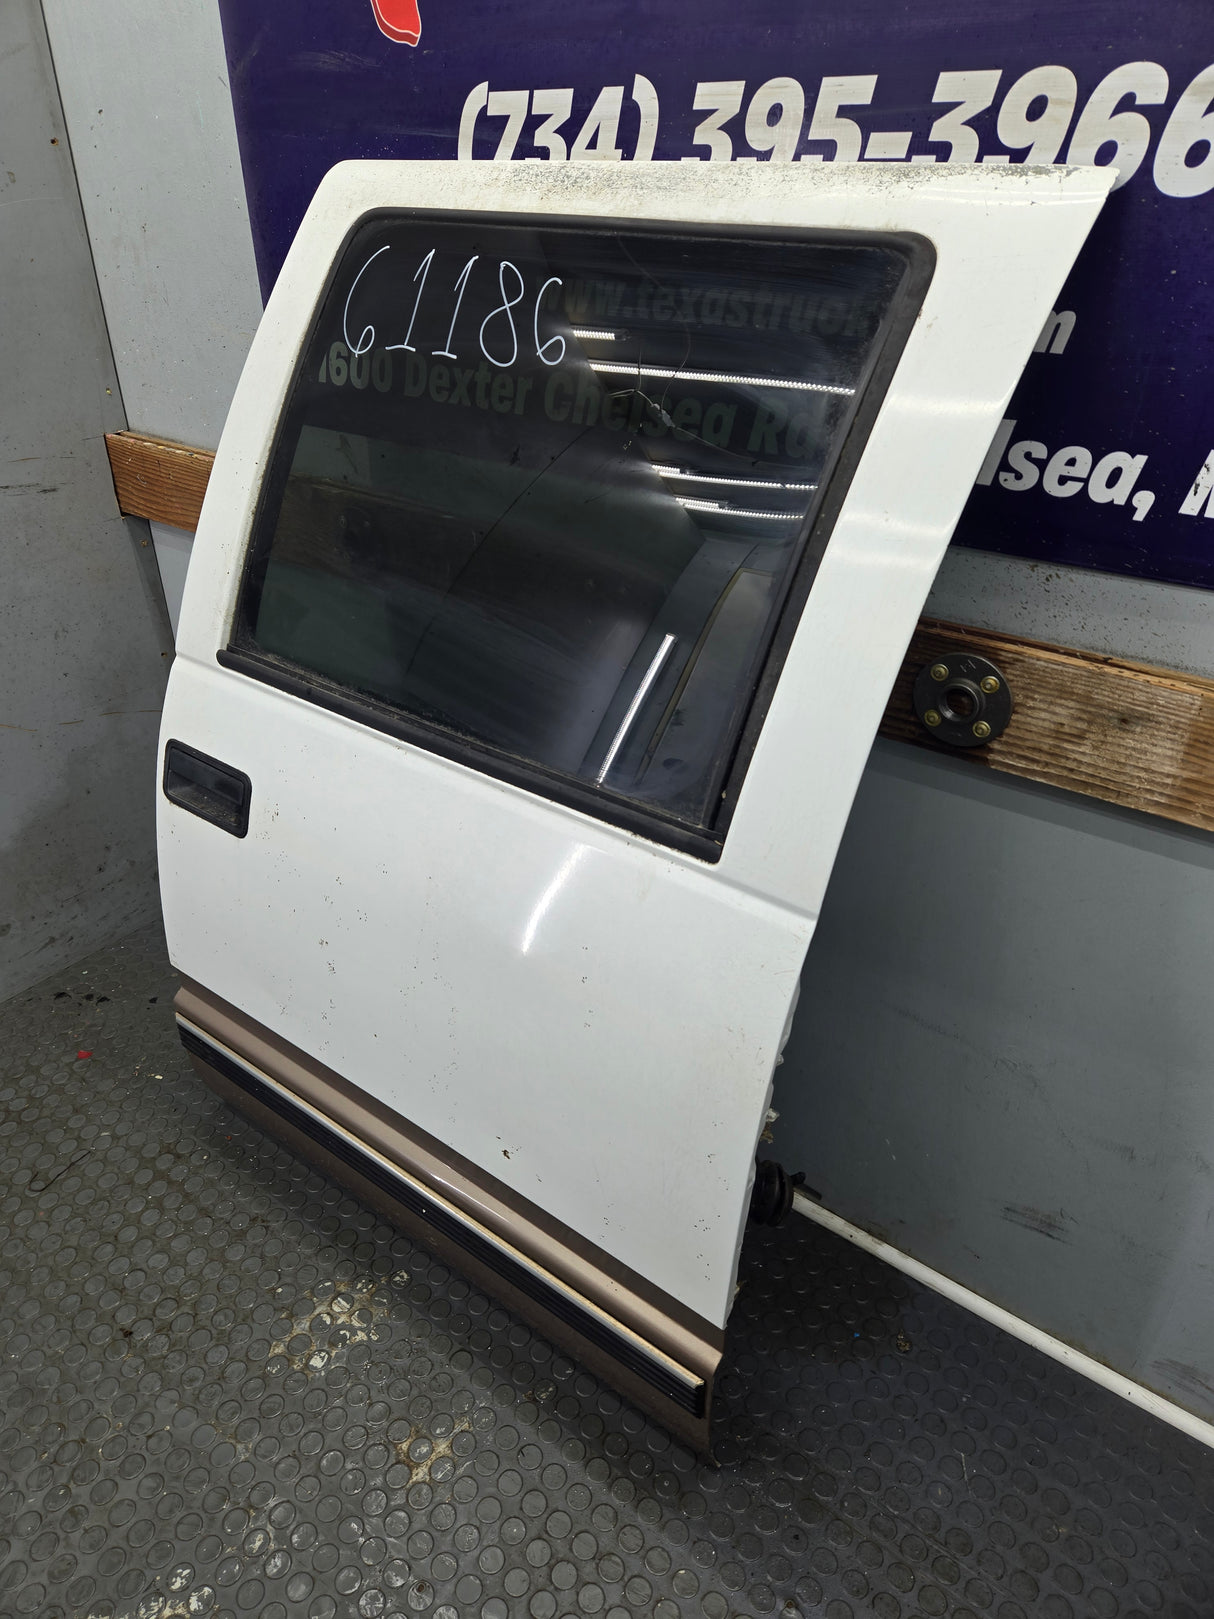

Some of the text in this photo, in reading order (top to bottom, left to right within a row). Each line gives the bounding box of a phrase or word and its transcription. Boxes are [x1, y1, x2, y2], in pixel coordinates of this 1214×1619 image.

[457, 73, 659, 161] (734)
[344, 245, 566, 367] 61186
[404, 351, 533, 417] Dexter
[545, 369, 737, 450] Chelsea
